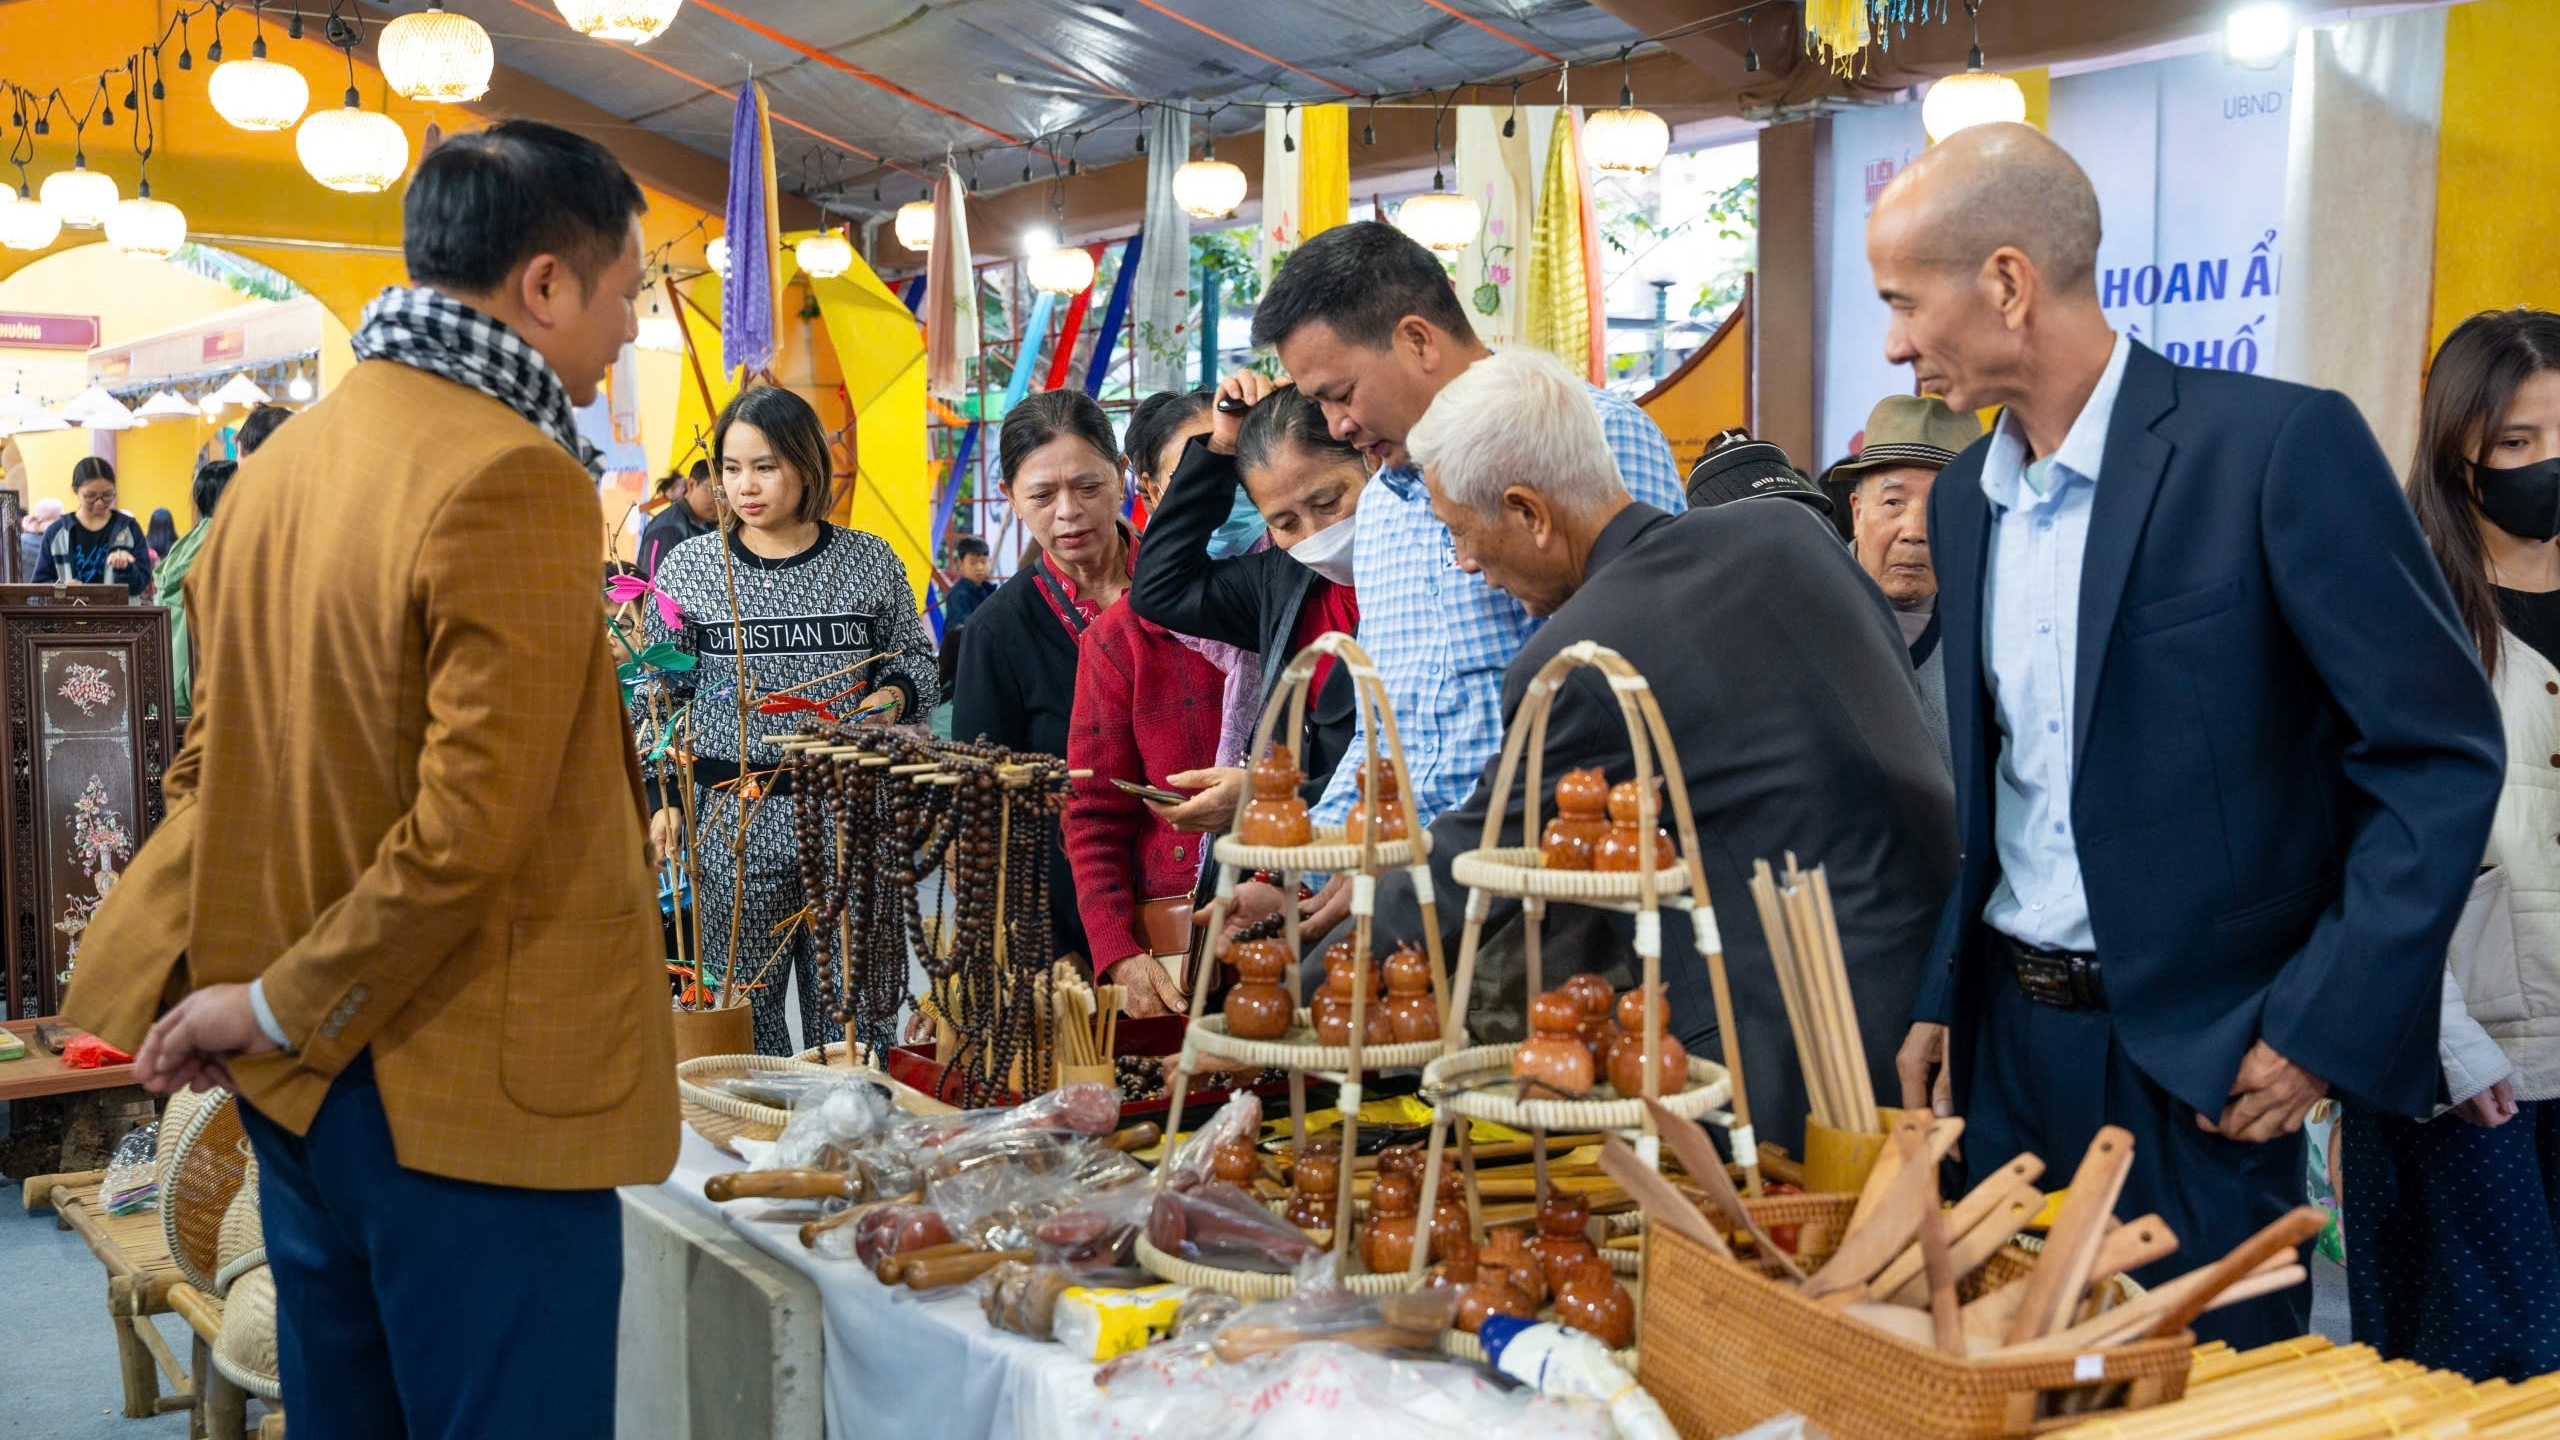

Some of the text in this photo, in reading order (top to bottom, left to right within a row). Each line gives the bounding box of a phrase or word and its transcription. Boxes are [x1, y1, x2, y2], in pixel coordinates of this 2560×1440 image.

[2223, 92, 2283, 120] UBND
[2102, 229, 2281, 309] HOAN Ẩ
[706, 621, 869, 650] CHRISTIAN DIOR
